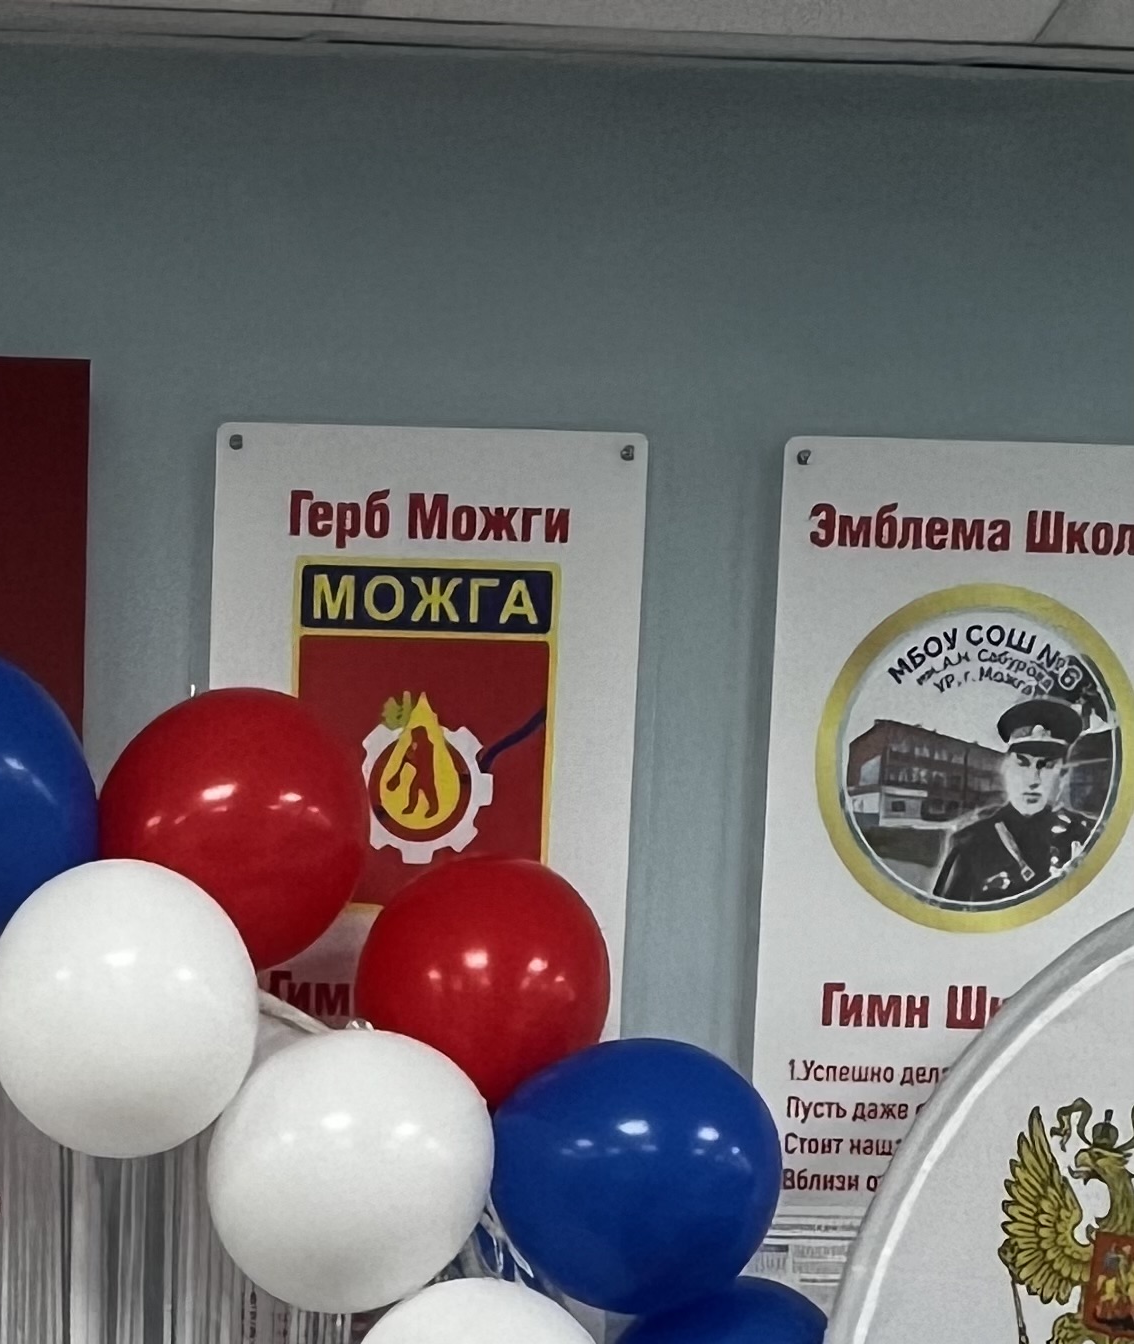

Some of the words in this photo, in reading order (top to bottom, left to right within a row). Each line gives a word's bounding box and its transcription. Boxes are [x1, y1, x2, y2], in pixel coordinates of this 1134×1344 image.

[288, 489, 391, 549] Герб
[407, 492, 571, 545] Можги
[809, 502, 1011, 551] Эмблема
[311, 573, 539, 625] МОЖГА
[887, 627, 958, 684] МБОУ
[965, 624, 1037, 655] СОШ
[269, 970, 351, 1017] Гим
[821, 982, 930, 1028] Гимн
[899, 1066, 952, 1087] дел
[786, 1096, 848, 1124] Пусть
[851, 1102, 910, 1122] даже
[849, 1138, 902, 1156] наш
